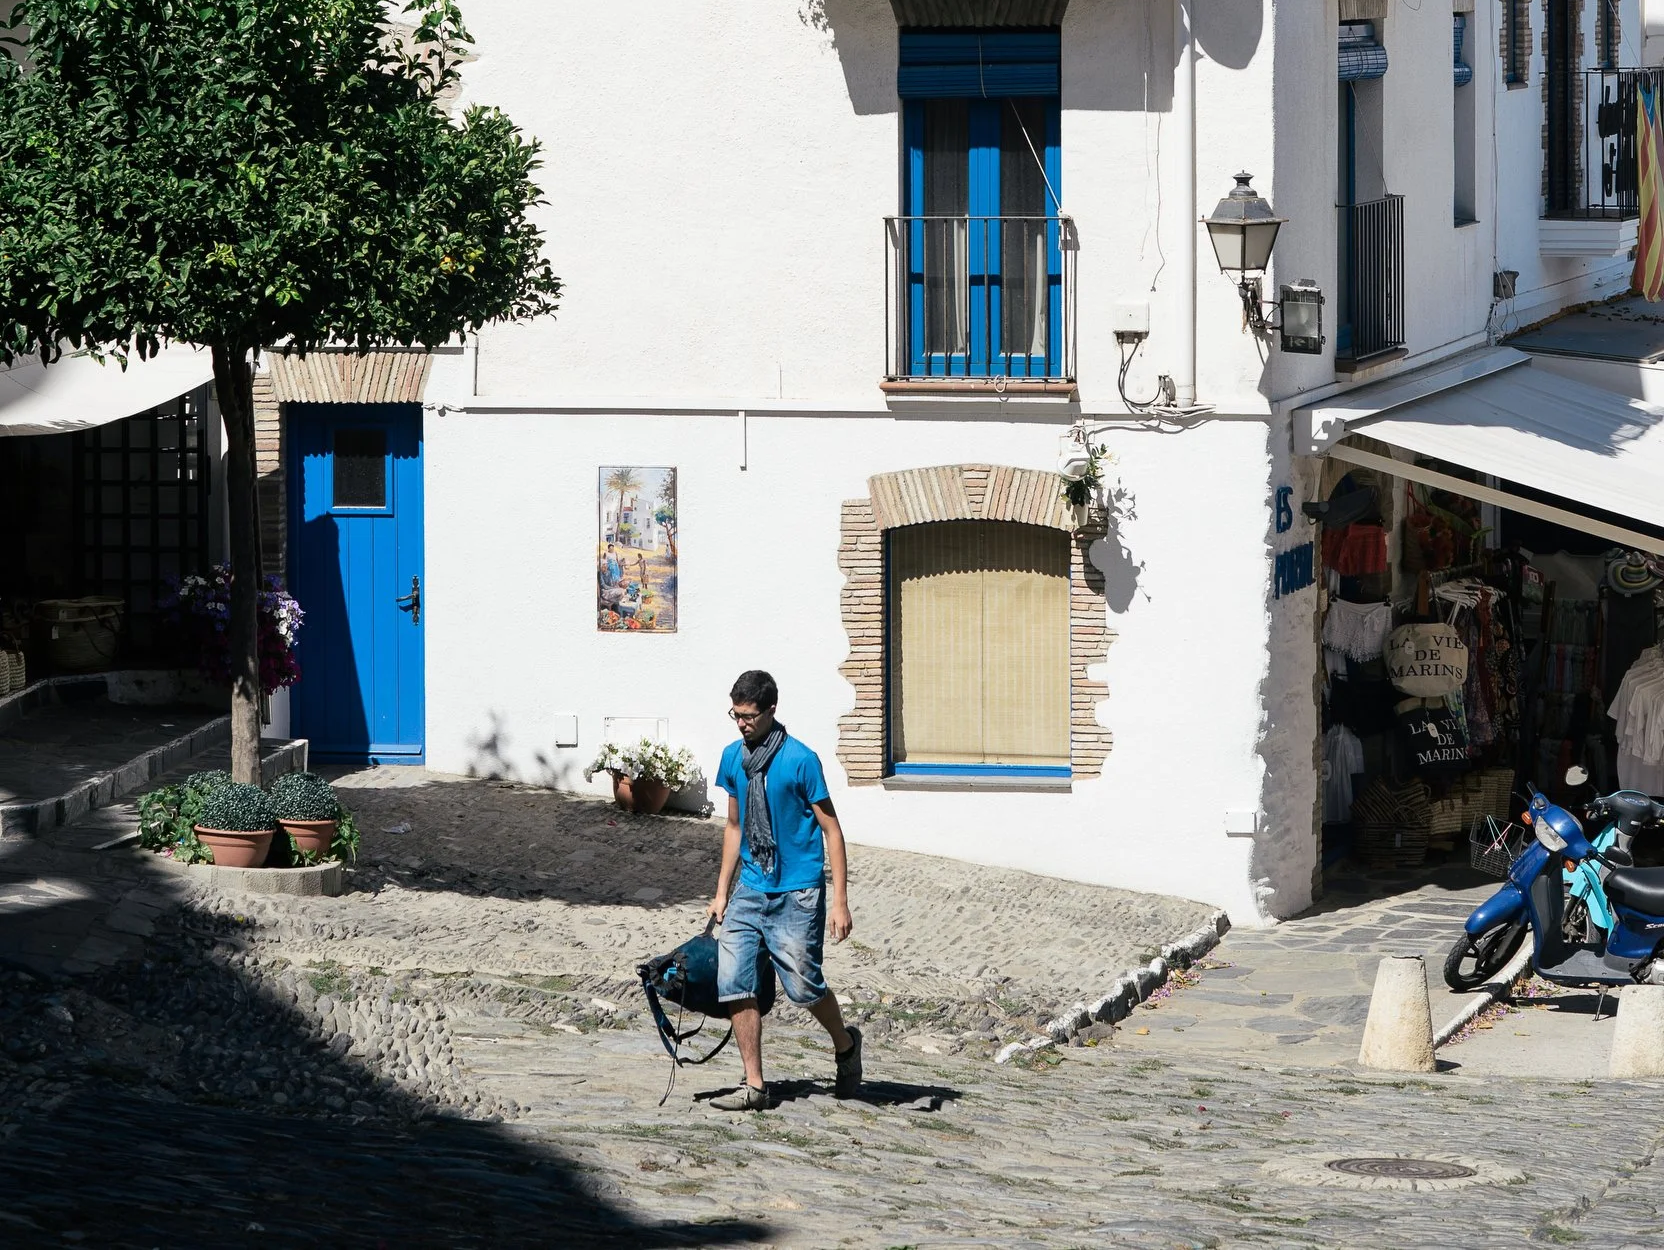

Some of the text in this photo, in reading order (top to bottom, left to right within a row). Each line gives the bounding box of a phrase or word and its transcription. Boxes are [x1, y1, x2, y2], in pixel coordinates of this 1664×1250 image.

[1432, 635, 1464, 650] VIE
[1414, 649, 1441, 661] DE
[1391, 663, 1463, 680] MARINS
[1440, 718, 1460, 730] VI
[1437, 733, 1455, 746] DE
